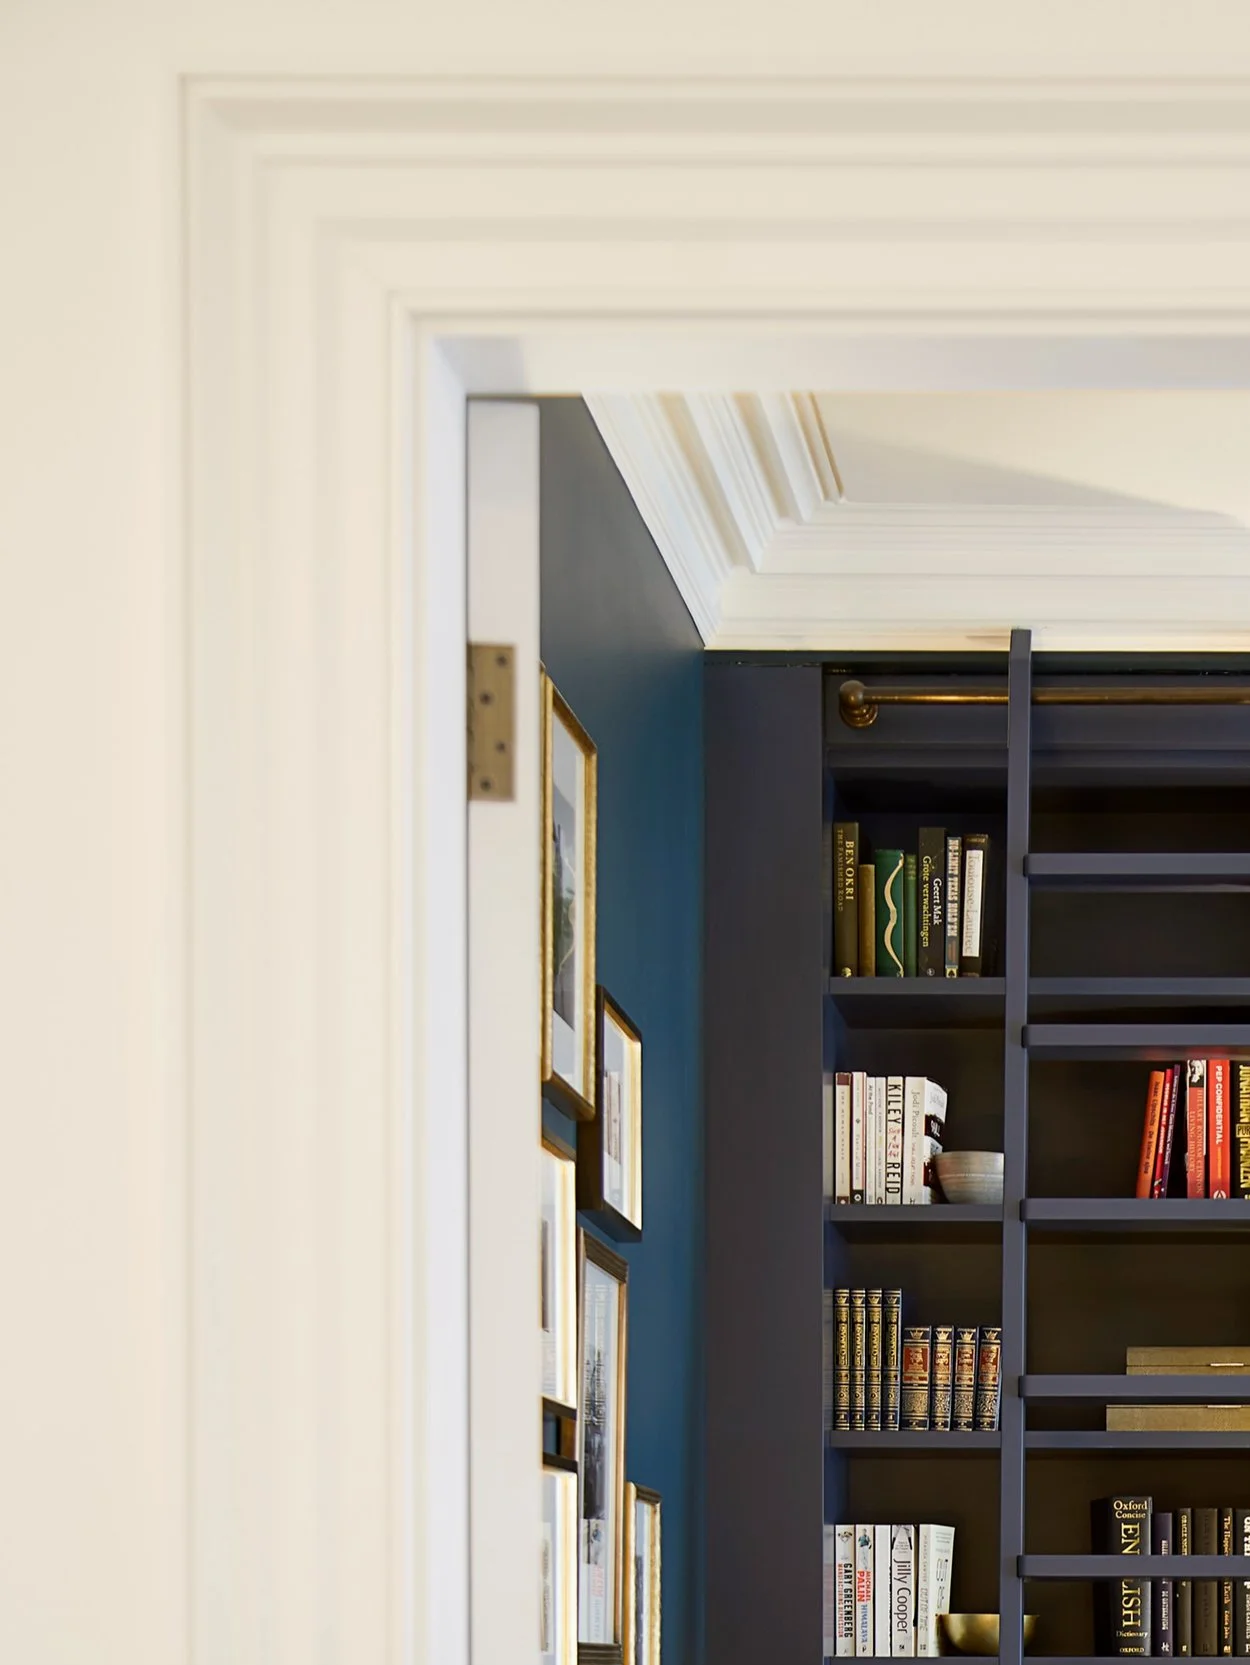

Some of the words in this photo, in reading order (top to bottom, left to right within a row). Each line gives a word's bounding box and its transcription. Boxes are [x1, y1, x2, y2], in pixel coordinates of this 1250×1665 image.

[845, 840, 855, 865] BEN
[922, 855, 931, 880] Grote
[845, 867, 855, 900] OKRI
[932, 878, 943, 903] Geert
[947, 877, 958, 901] TEXAS
[920, 883, 931, 948] verwachtingen
[933, 905, 943, 926] Mak
[964, 854, 980, 954] Toulouse-Lautrec
[888, 1084, 901, 1124] KILEY
[911, 1091, 921, 1108] Jodi
[912, 1110, 921, 1138] Picoult
[886, 1162, 900, 1194] REID
[1113, 1500, 1148, 1511] Oxford
[1115, 1511, 1146, 1519] Concise
[844, 1563, 853, 1585] GARY
[893, 1559, 912, 1584] Jilly
[857, 1571, 865, 1602] PALIN
[844, 1588, 853, 1638] GREENBERG
[894, 1587, 912, 1634] Cooper
[1115, 1630, 1148, 1639] Dictionary
